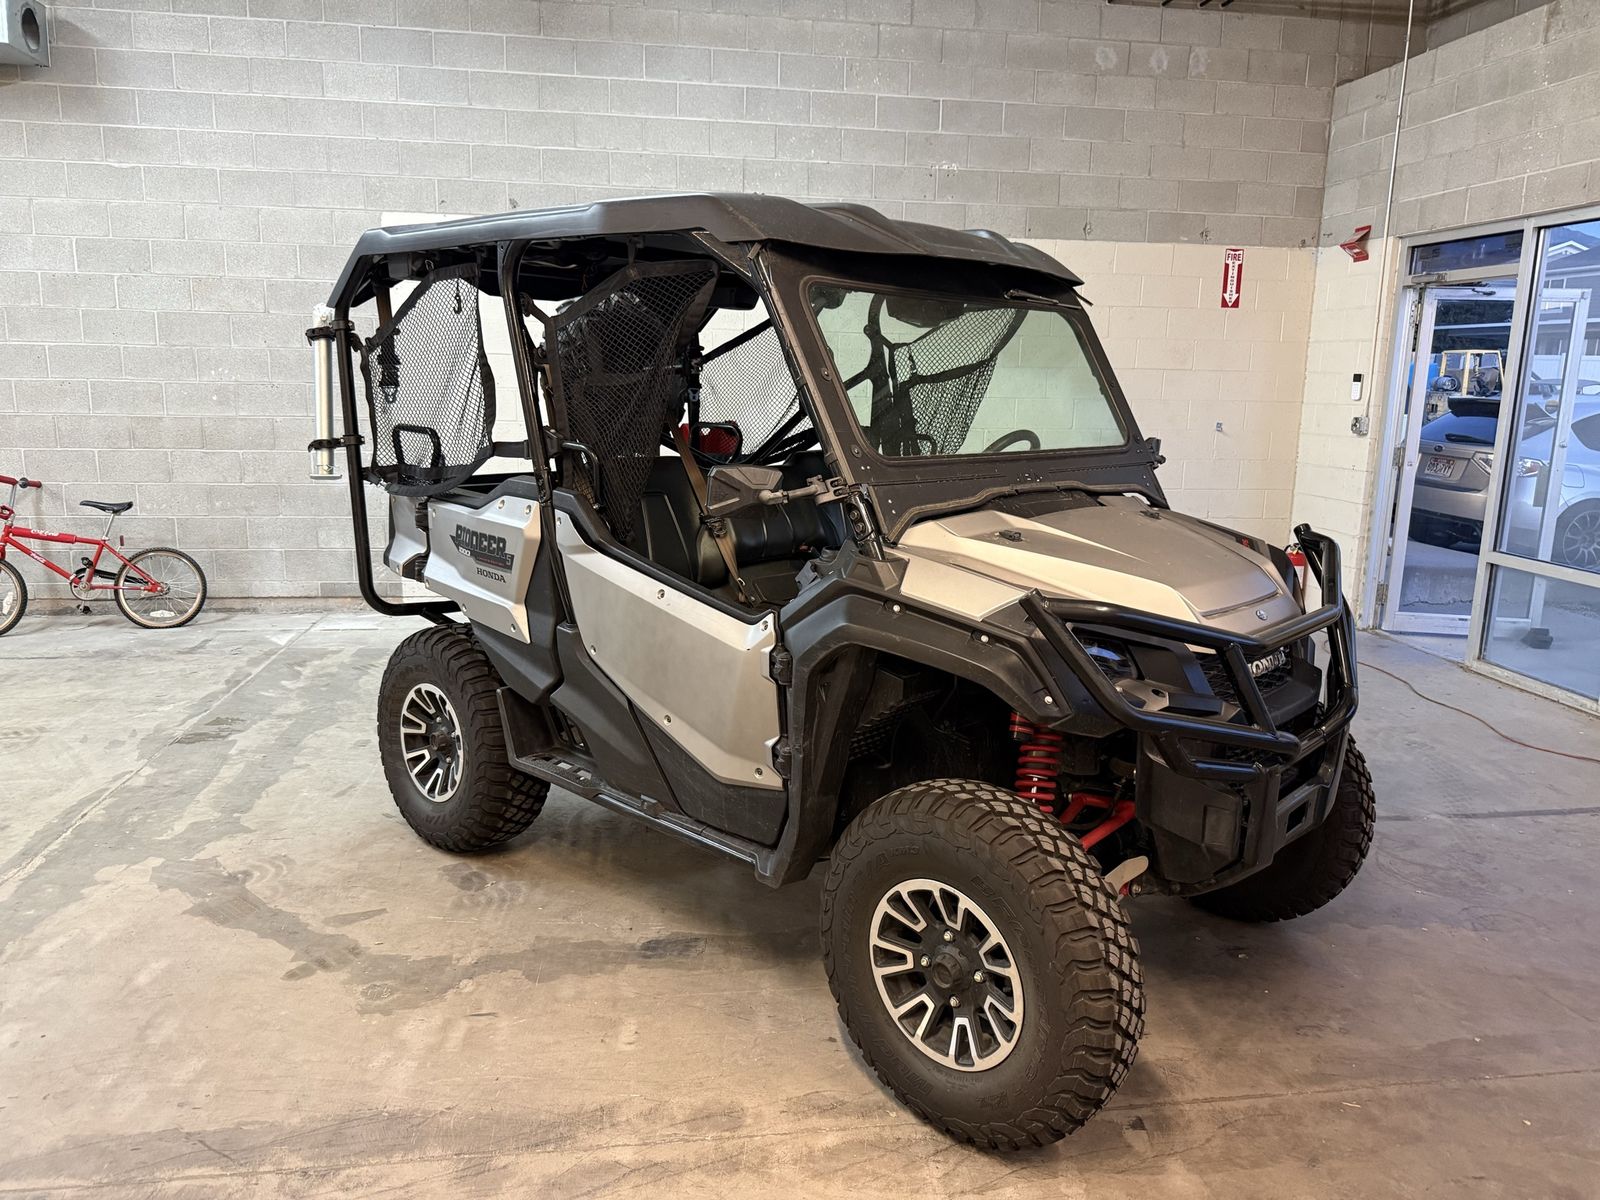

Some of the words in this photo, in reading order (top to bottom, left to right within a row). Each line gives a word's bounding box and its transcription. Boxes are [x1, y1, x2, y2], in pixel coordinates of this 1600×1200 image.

[1227, 253, 1241, 261] FIRE
[455, 524, 507, 556] PIONEER
[476, 567, 506, 583] HONDA
